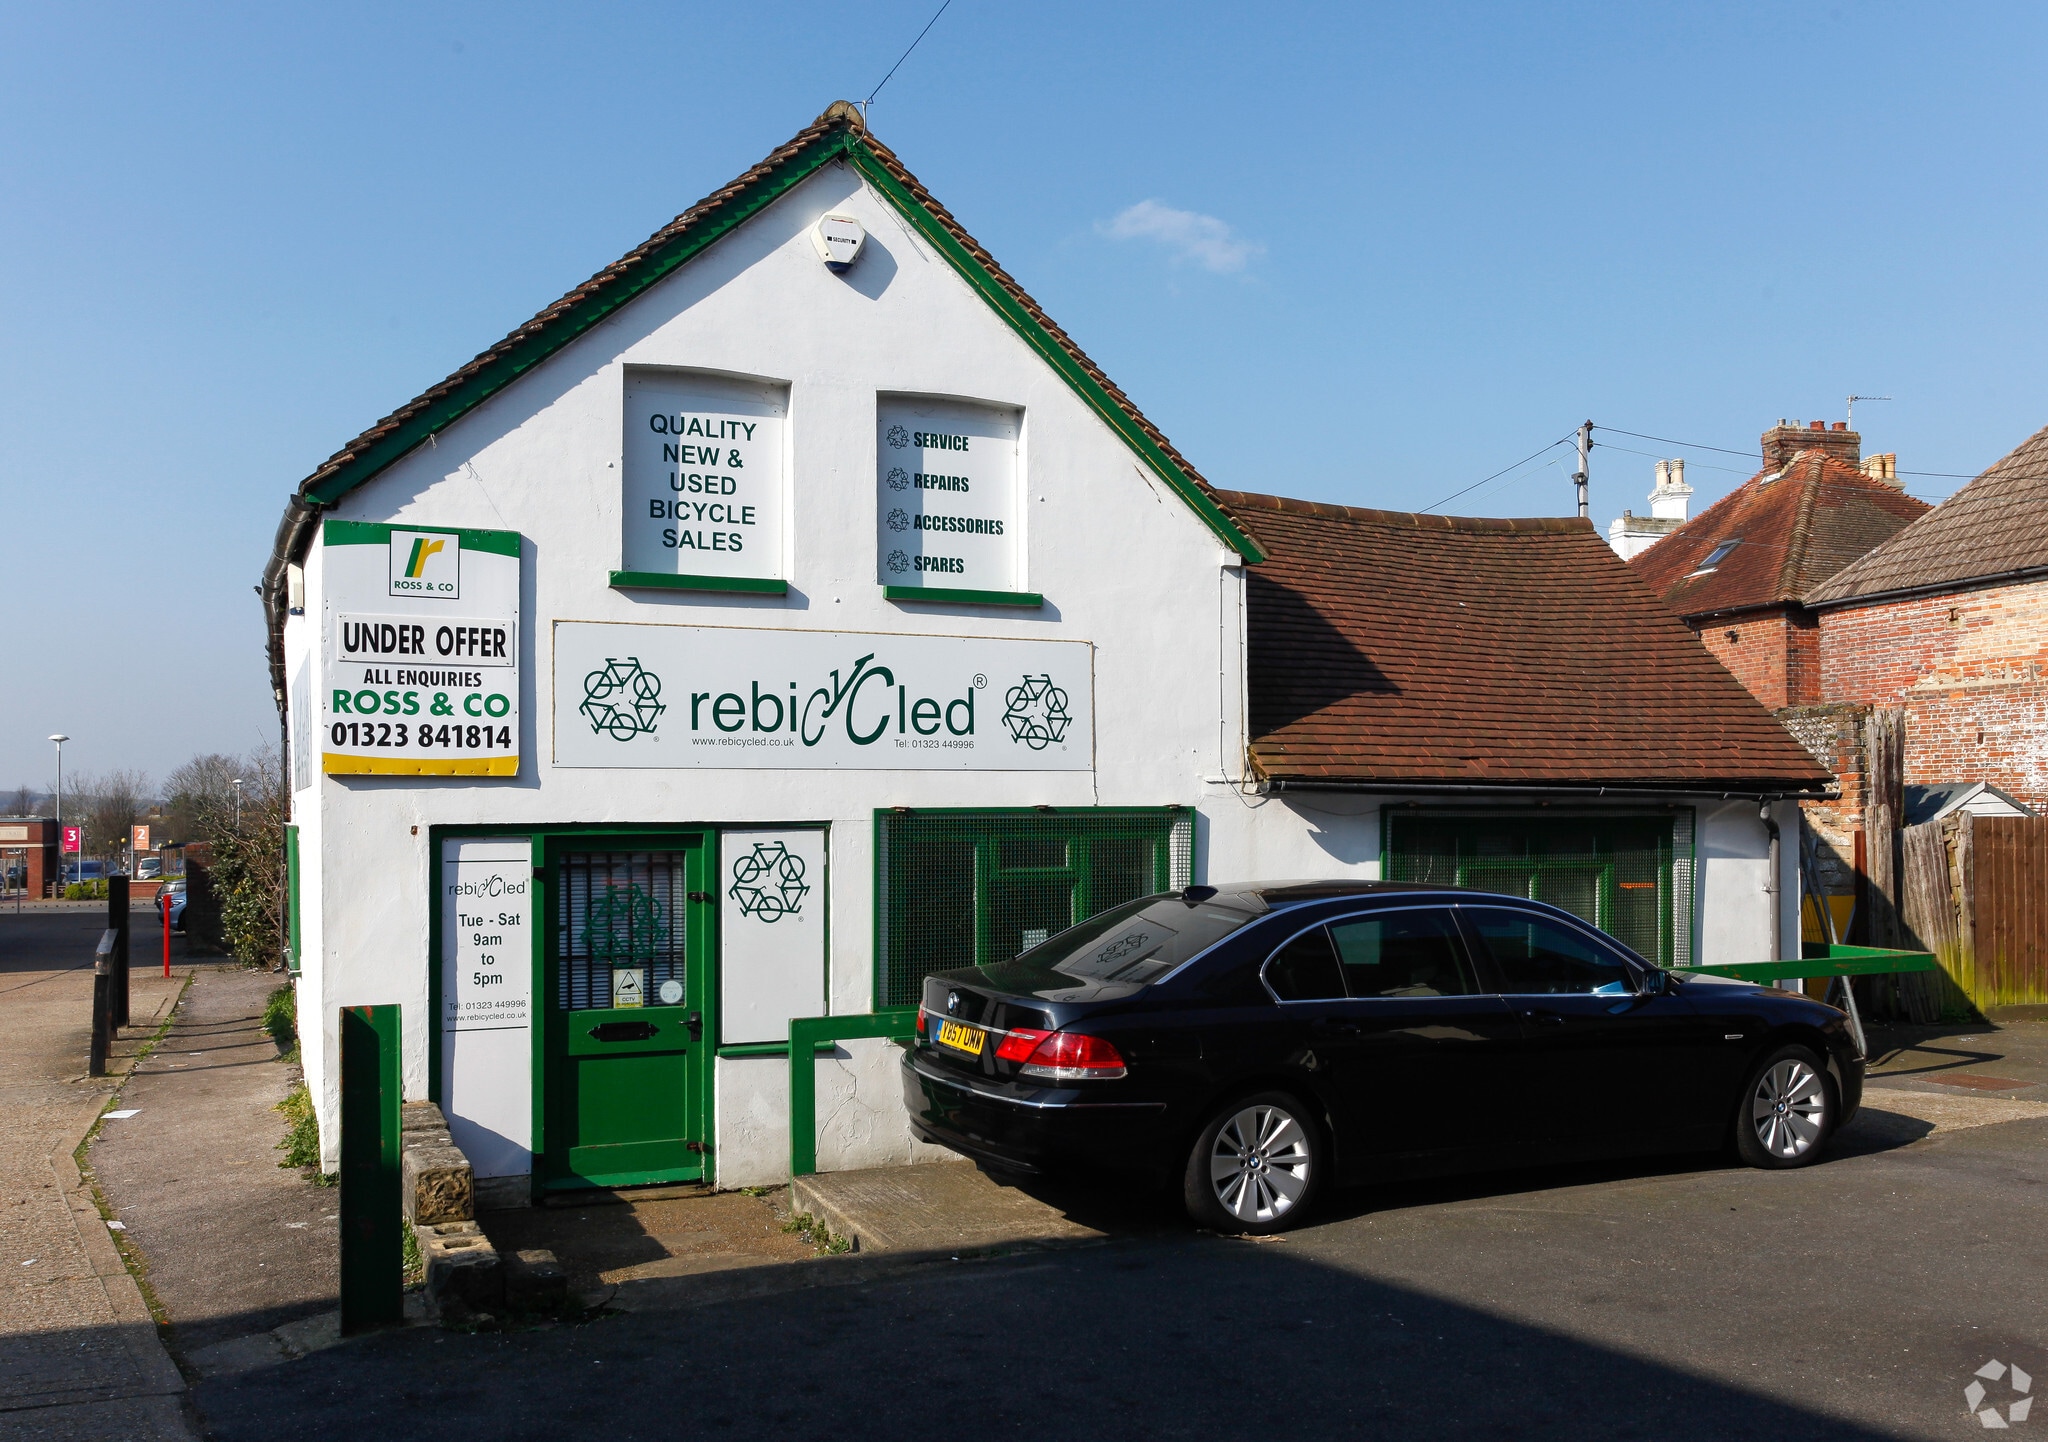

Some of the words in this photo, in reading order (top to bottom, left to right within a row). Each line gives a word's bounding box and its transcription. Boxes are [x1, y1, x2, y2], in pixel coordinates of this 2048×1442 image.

[650, 413, 757, 441] QUALITY
[914, 431, 969, 452] SERVICE
[663, 445, 720, 466] NEW
[728, 449, 744, 468] &
[670, 473, 737, 495] USED
[914, 473, 969, 492] REPAIRS
[649, 499, 756, 525] BICYCLE
[914, 515, 1004, 535] ACCESSORIES
[662, 528, 743, 551] SALES
[914, 556, 964, 573] SPARES
[394, 581, 422, 590] ROSS
[438, 583, 454, 591] CO
[344, 622, 425, 654] UNDER
[436, 626, 506, 657] OFFER
[364, 669, 392, 685] ALL
[398, 670, 482, 688] ENQUIRIES
[333, 690, 420, 715] ROSS
[430, 692, 455, 716] &
[464, 694, 510, 718] CO
[332, 723, 409, 747] 01323
[418, 724, 511, 748] 841814
[692, 737, 795, 747] www.rebicycled.co.uk
[894, 739, 909, 748] Tel:
[912, 739, 939, 748] 01323
[942, 740, 974, 749] 449996
[68, 830, 76, 841] 3
[137, 829, 145, 839] 2
[459, 914, 483, 927] Tue
[498, 913, 520, 925] Sat
[473, 933, 502, 946] 9am
[481, 953, 494, 965] to
[473, 972, 503, 987] 5pm
[448, 1002, 463, 1011] Tel:
[466, 1001, 492, 1010] 01323
[495, 1000, 526, 1008] 449996
[447, 1012, 526, 1021] www.rebicycled.co.uk
